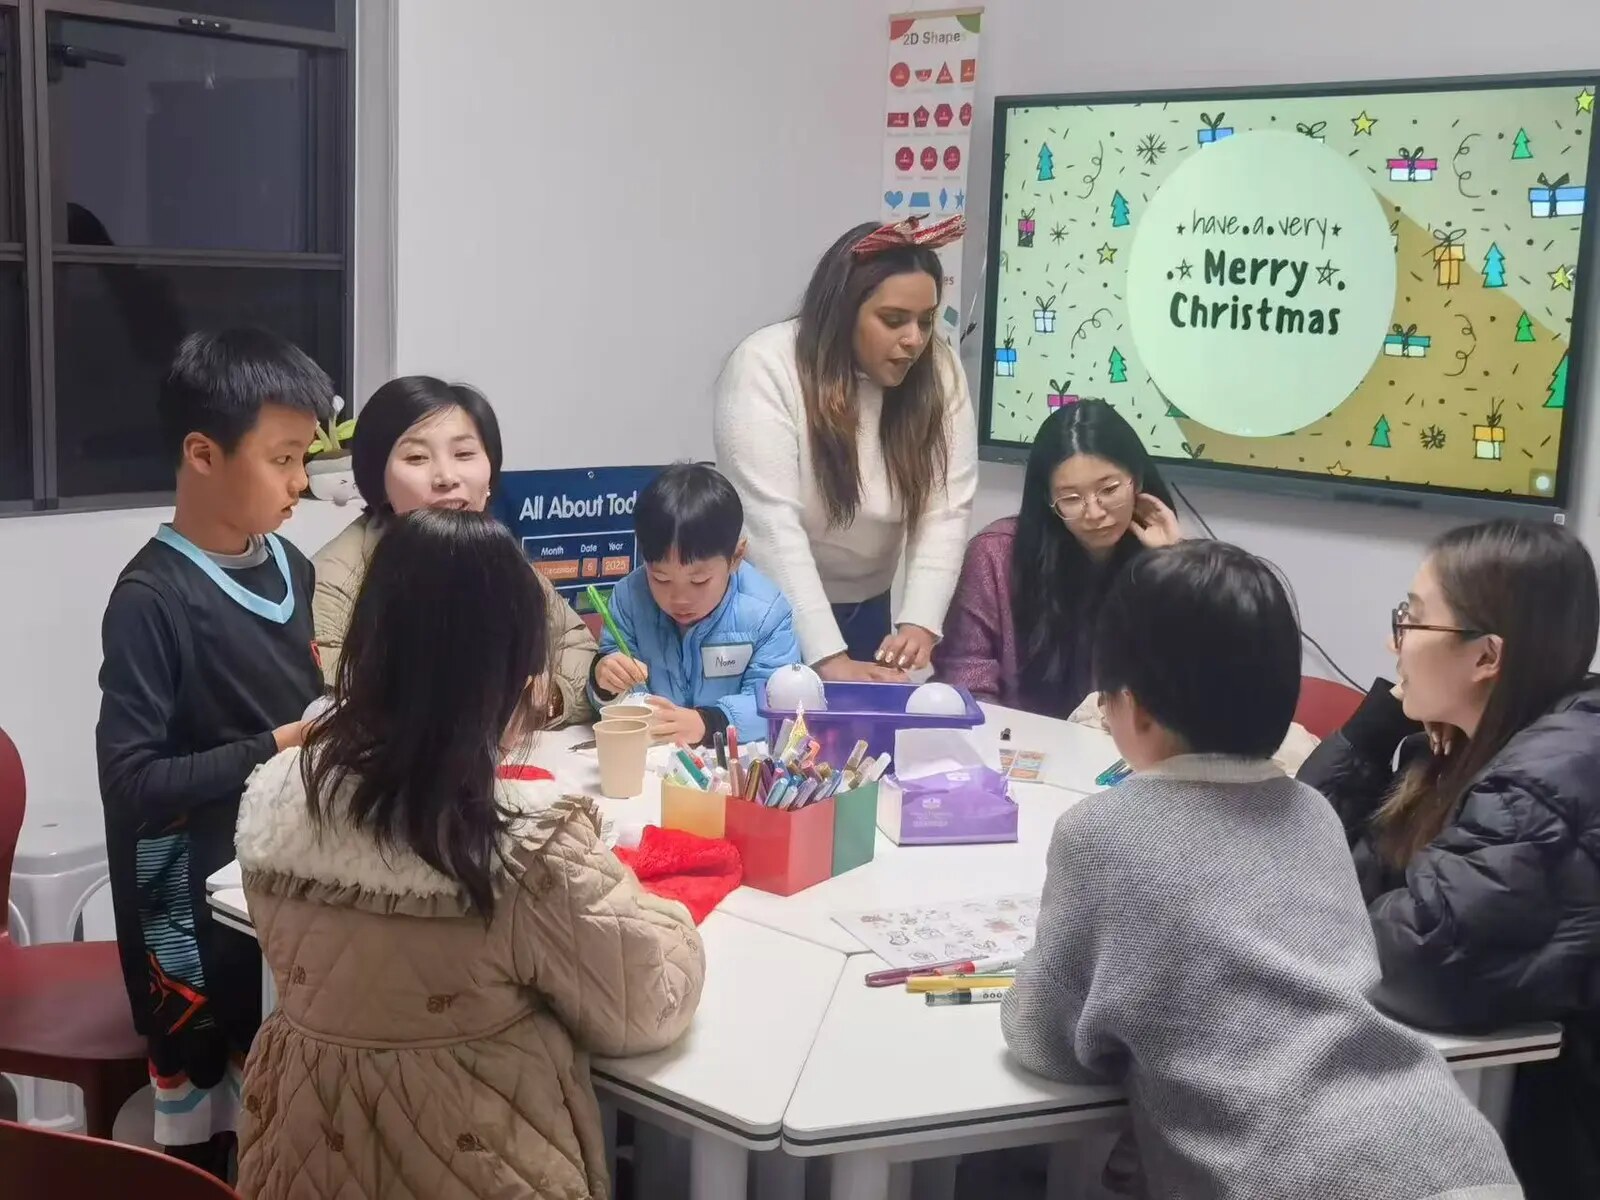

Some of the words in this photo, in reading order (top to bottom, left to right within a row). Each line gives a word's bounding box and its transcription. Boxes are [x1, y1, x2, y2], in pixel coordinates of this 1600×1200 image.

[903, 32, 919, 46] 2D
[1204, 248, 1309, 298] Merry
[1169, 291, 1341, 336] Christmas
[519, 495, 544, 521] All
[547, 494, 604, 520] About
[541, 545, 564, 556] Month
[580, 544, 598, 553] Date
[608, 542, 624, 552] Year
[587, 562, 594, 572] 6
